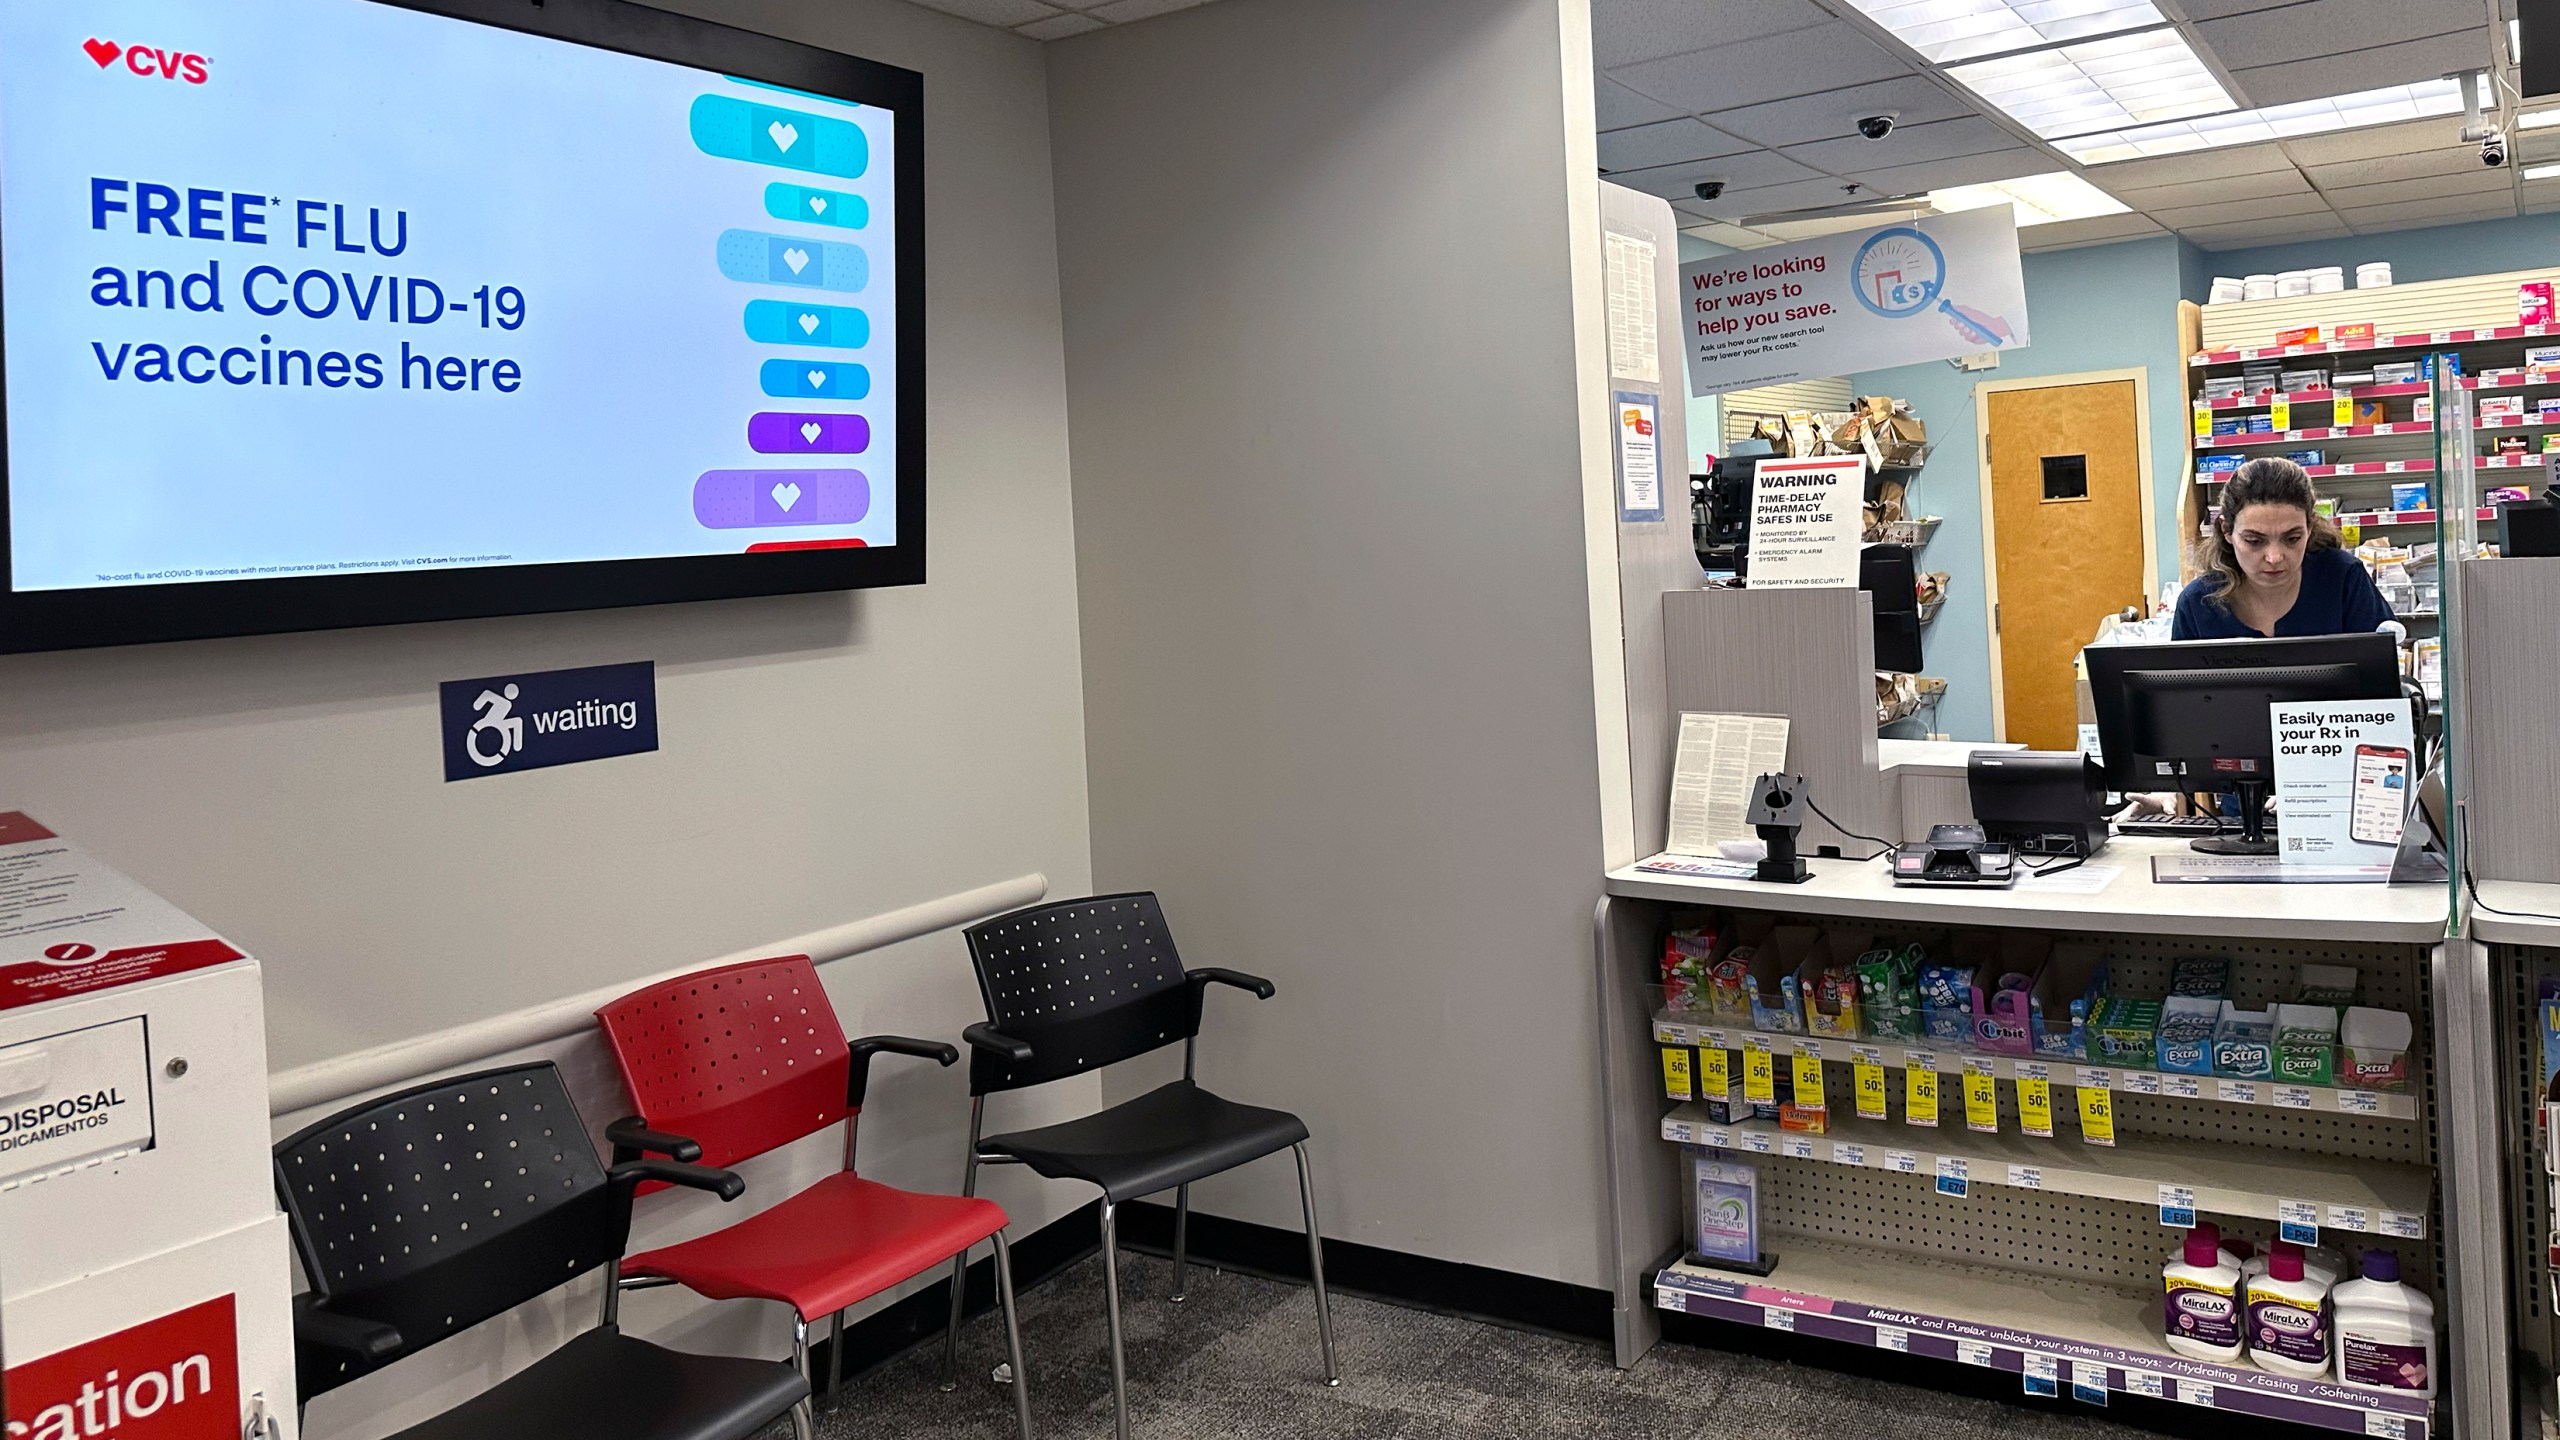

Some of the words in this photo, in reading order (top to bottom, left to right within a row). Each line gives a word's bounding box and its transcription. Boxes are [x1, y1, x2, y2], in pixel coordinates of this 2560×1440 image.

[126, 44, 209, 85] CVS
[297, 199, 408, 257] FLU
[1753, 256, 1825, 280] looking
[90, 260, 224, 313] and
[241, 265, 526, 331] COVID-19
[1695, 297, 1722, 313] for
[1727, 287, 1777, 307] ways
[1782, 283, 1802, 298] to
[1697, 317, 1739, 336] help
[1743, 311, 1779, 332] you
[1785, 302, 1837, 321] save.
[1700, 344, 1715, 352] Ask
[1717, 342, 1726, 350] us
[1727, 340, 1745, 348] how
[1746, 337, 1760, 345] our
[1761, 334, 1778, 342] new
[1780, 328, 1807, 339] search
[1808, 325, 1825, 335] tool
[2344, 327, 2365, 335] Advil
[1701, 354, 1718, 363] may
[1719, 350, 1741, 359] lower
[1743, 347, 1760, 357] your
[1762, 345, 1773, 353] Rx
[91, 334, 384, 389] vaccines
[401, 341, 522, 393] here
[1760, 473, 1837, 488] WARNING
[1758, 492, 1827, 504] TIME-DELAY
[1757, 503, 1821, 514] PHARMACY
[1757, 515, 1793, 525] SAFES
[1795, 514, 1806, 523] IN
[1810, 513, 1833, 522] USE
[134, 572, 145, 580] flu
[147, 571, 162, 579] and
[164, 569, 204, 578] COVID-19
[205, 567, 239, 576] vaccines
[241, 566, 257, 574] with
[258, 565, 277, 573] most
[279, 563, 315, 572] insurance
[316, 562, 336, 571] plans.
[338, 561, 379, 569] Restrictions
[380, 560, 399, 569] apply.
[401, 558, 416, 566] Visit
[416, 557, 448, 565] CVS.com
[459, 555, 476, 563] more
[477, 554, 512, 562] information.
[532, 698, 637, 734] waiting
[2279, 712, 2325, 727] Easily
[2329, 712, 2395, 726] manage
[2279, 729, 2316, 742] your
[2320, 727, 2341, 739] Rx
[2345, 726, 2360, 739] in
[2281, 744, 2308, 755] our
[2311, 744, 2343, 756] app
[97, 950, 168, 968] medication
[2175, 981, 2222, 991] Extra
[1977, 1018, 2026, 1041] Orbit
[2095, 1035, 2146, 1056] Orbit
[2169, 1050, 2200, 1061] Extra
[2221, 1050, 2263, 1064] Extra
[2285, 1060, 2317, 1071] Extra
[2356, 1064, 2390, 1074] Extra
[0, 1087, 126, 1135] DISPOSAL
[1948, 1182, 1966, 1194] E70
[1703, 1215, 1744, 1230] One-Step
[2173, 1213, 2193, 1224] E89
[2295, 1230, 2316, 1241] P65
[2169, 1280, 2184, 1289] 20%
[1781, 1296, 1804, 1306] Aftera
[2182, 1297, 2226, 1311] MiraLAX
[2251, 1293, 2266, 1301] 20%
[2264, 1311, 2309, 1327] MiraLAX
[2345, 1340, 2377, 1352] Purelax
[1867, 1309, 1919, 1324] MiraLAX
[1922, 1320, 1943, 1329] and
[1946, 1323, 1986, 1337] Purelax
[1990, 1331, 2032, 1345] unblock
[2034, 1337, 2060, 1350] your
[2063, 1341, 2100, 1356] system
[2103, 1348, 2114, 1359] in
[2117, 1350, 2126, 1360] 3
[2129, 1355, 2162, 1368] ways:
[2177, 1361, 2237, 1383] Hydrating
[2257, 1376, 2299, 1393] Easing
[2319, 1385, 2379, 1406] Softening
